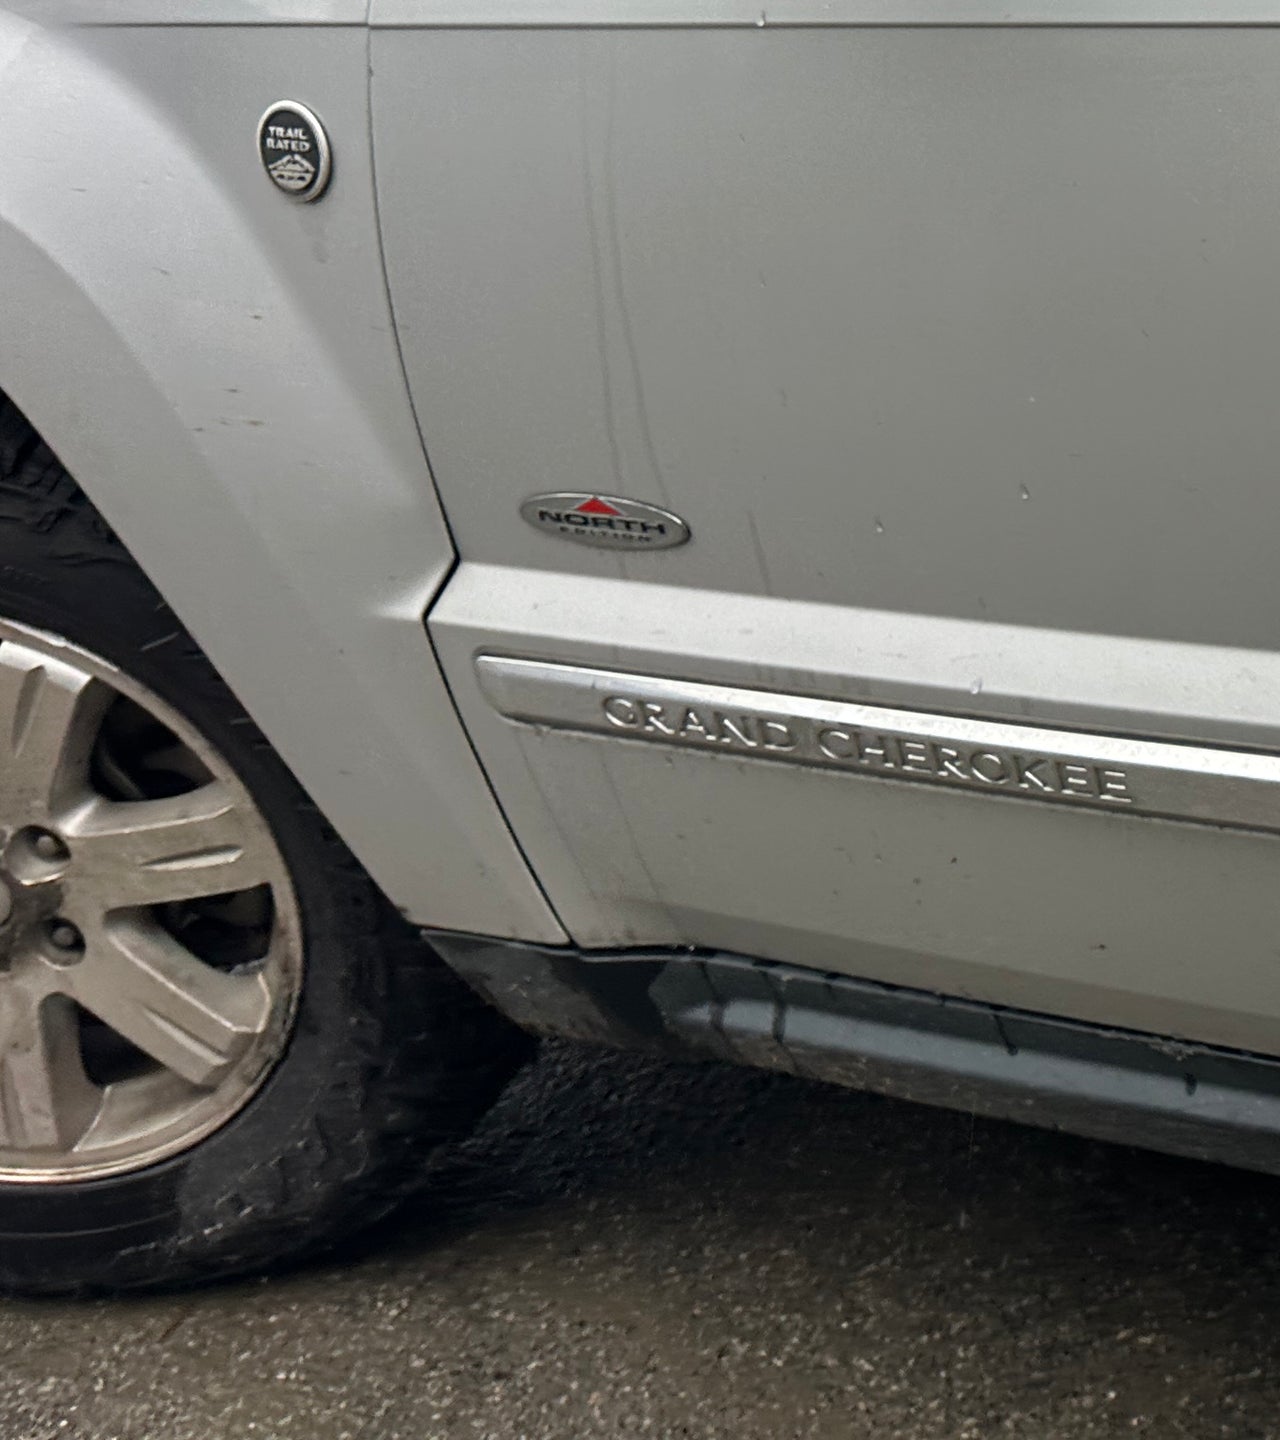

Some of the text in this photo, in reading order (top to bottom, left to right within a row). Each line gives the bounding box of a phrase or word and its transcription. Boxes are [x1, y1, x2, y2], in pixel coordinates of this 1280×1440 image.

[267, 126, 308, 140] TRAIL
[266, 138, 311, 152] RATED
[538, 510, 667, 535] NORTH
[559, 526, 653, 543] EDITION
[602, 694, 1133, 804] GRAND CHEROKEE
